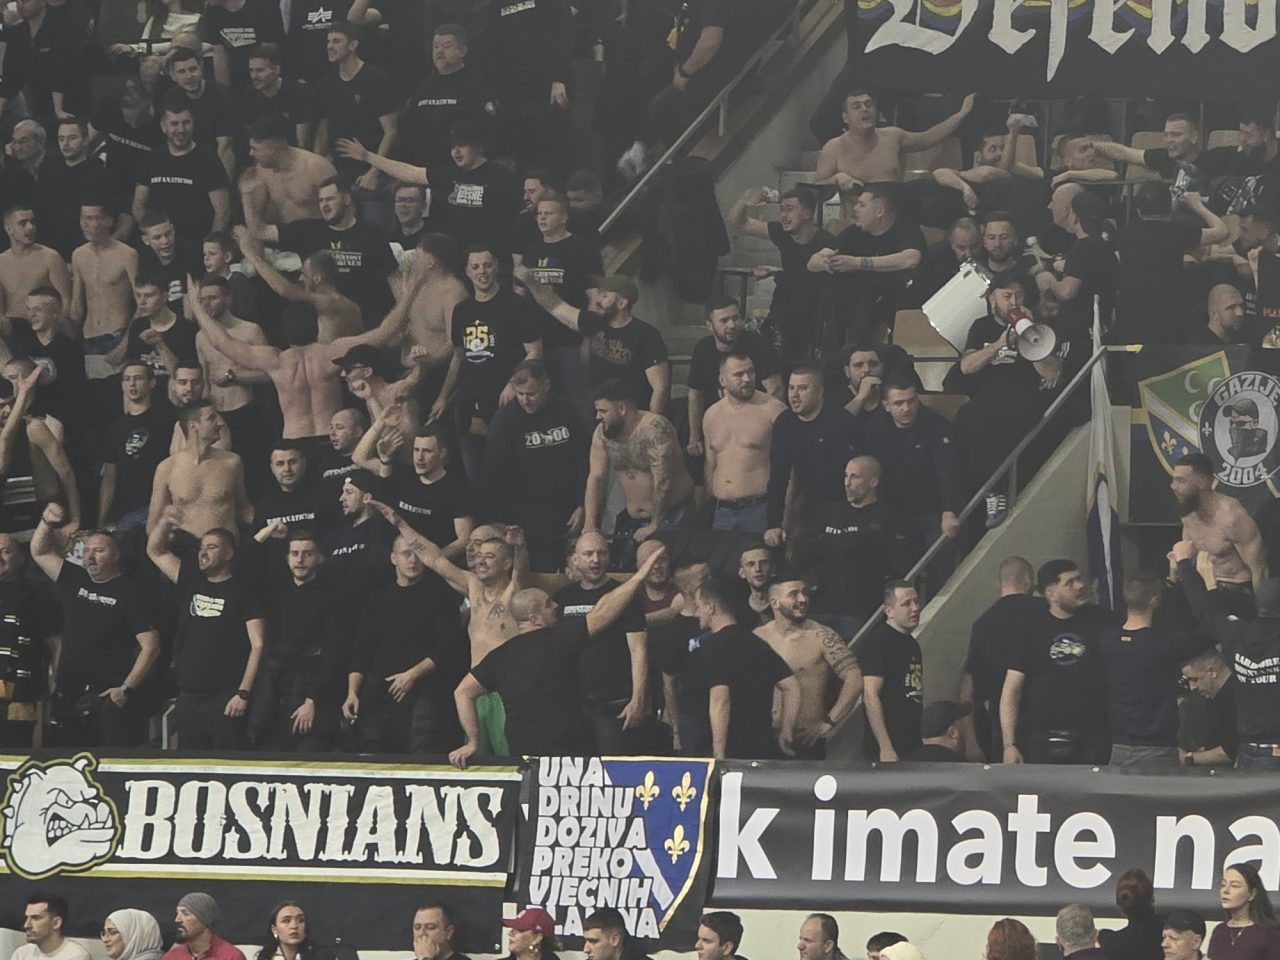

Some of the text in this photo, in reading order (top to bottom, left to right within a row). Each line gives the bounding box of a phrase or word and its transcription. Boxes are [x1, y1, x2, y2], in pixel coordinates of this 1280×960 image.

[466, 326, 489, 351] 25
[1217, 461, 1269, 483] 2004
[538, 756, 603, 787] UNA
[538, 786, 635, 817] DRINU
[116, 780, 502, 868] BOSNIANS
[535, 816, 647, 849] DOZIVA
[716, 773, 780, 879] k
[811, 775, 1116, 888] imate
[531, 847, 634, 879] PREKO
[529, 876, 654, 908] VJEČNIH
